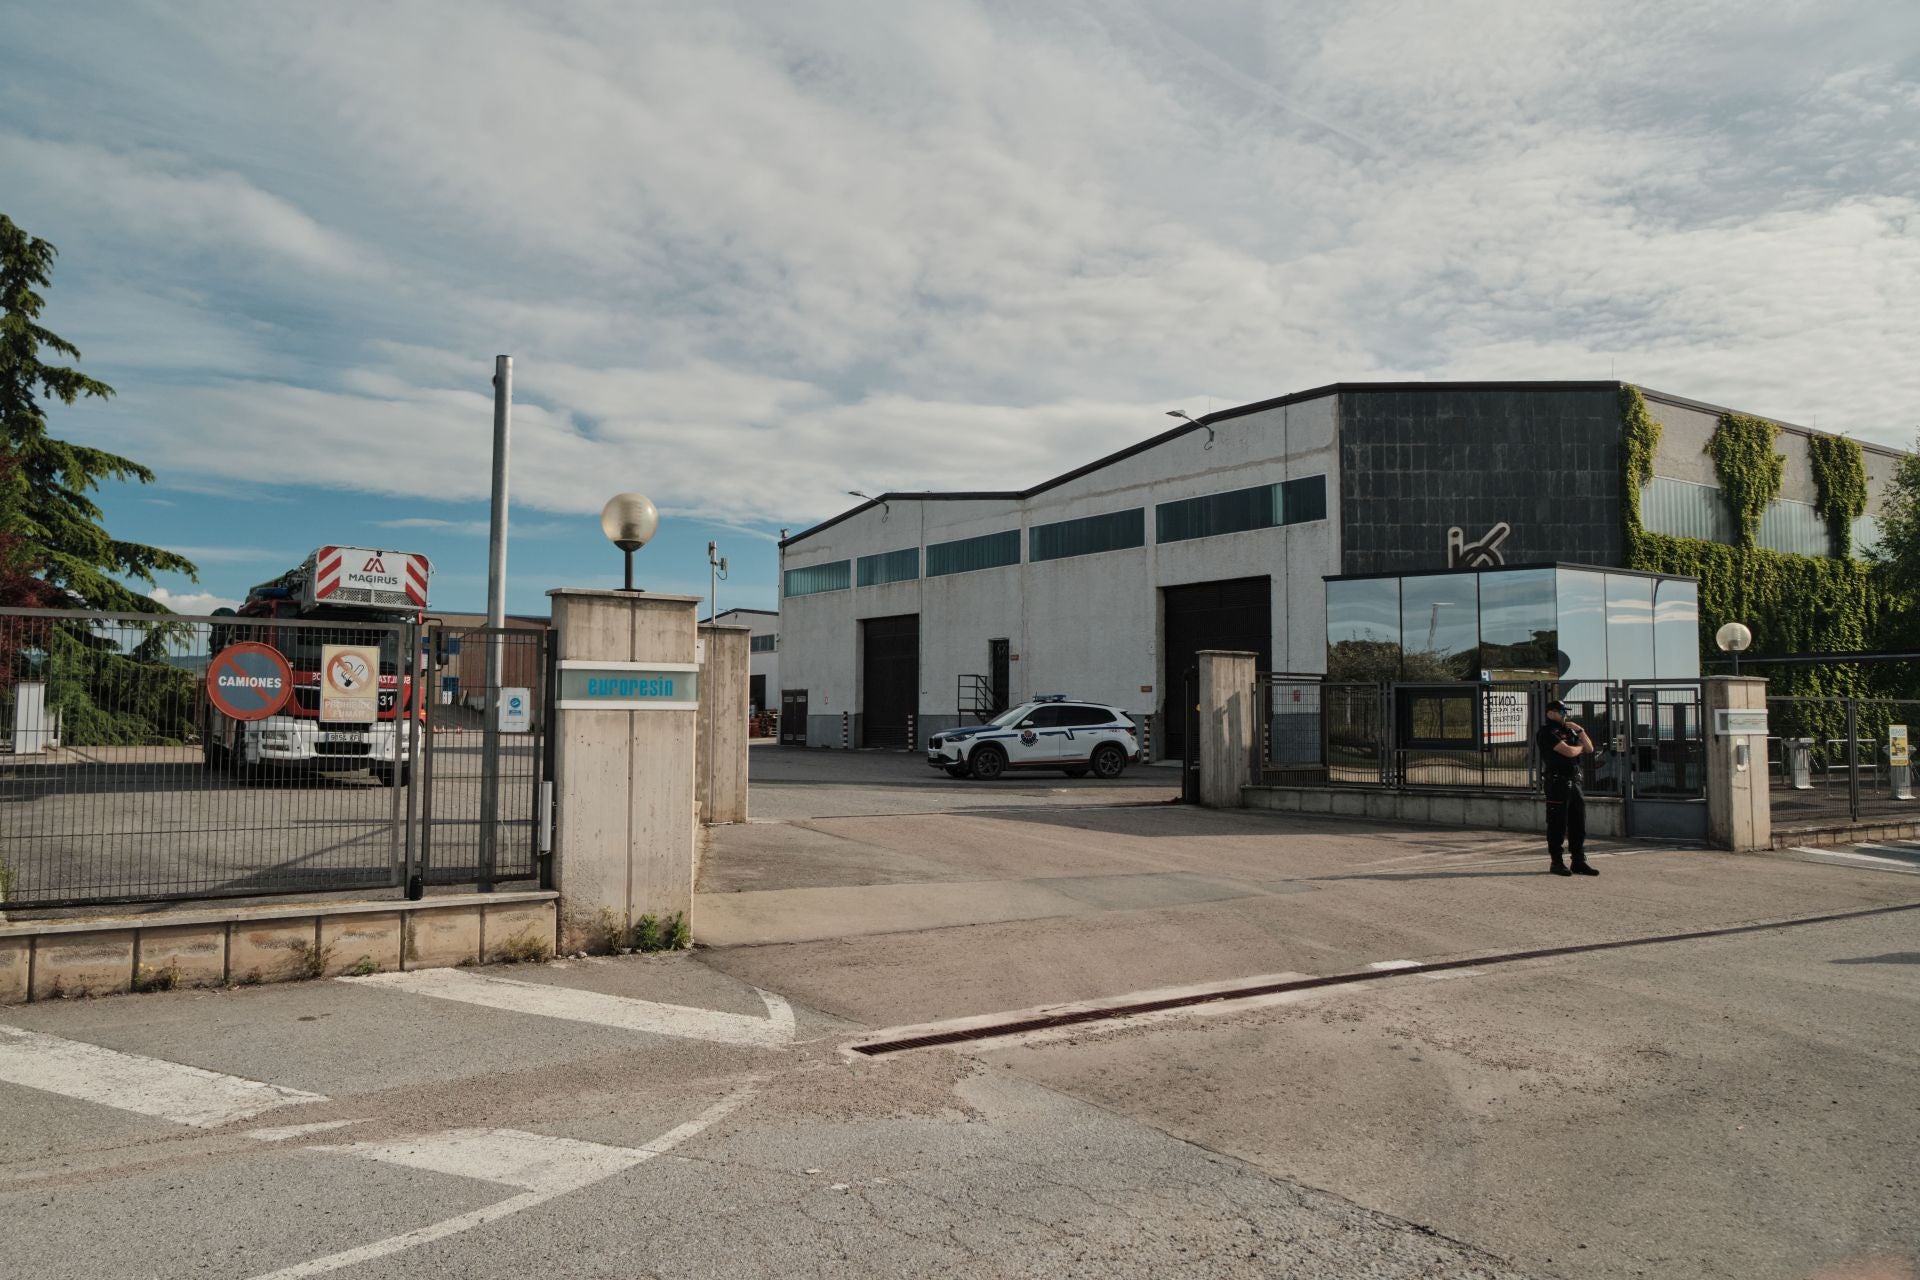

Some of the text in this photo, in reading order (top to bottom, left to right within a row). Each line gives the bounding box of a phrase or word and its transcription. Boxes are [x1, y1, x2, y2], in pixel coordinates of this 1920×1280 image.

[348, 573, 398, 585] MAGIRUS
[218, 676, 282, 688] CAMIONES
[588, 676, 673, 696] euroresin
